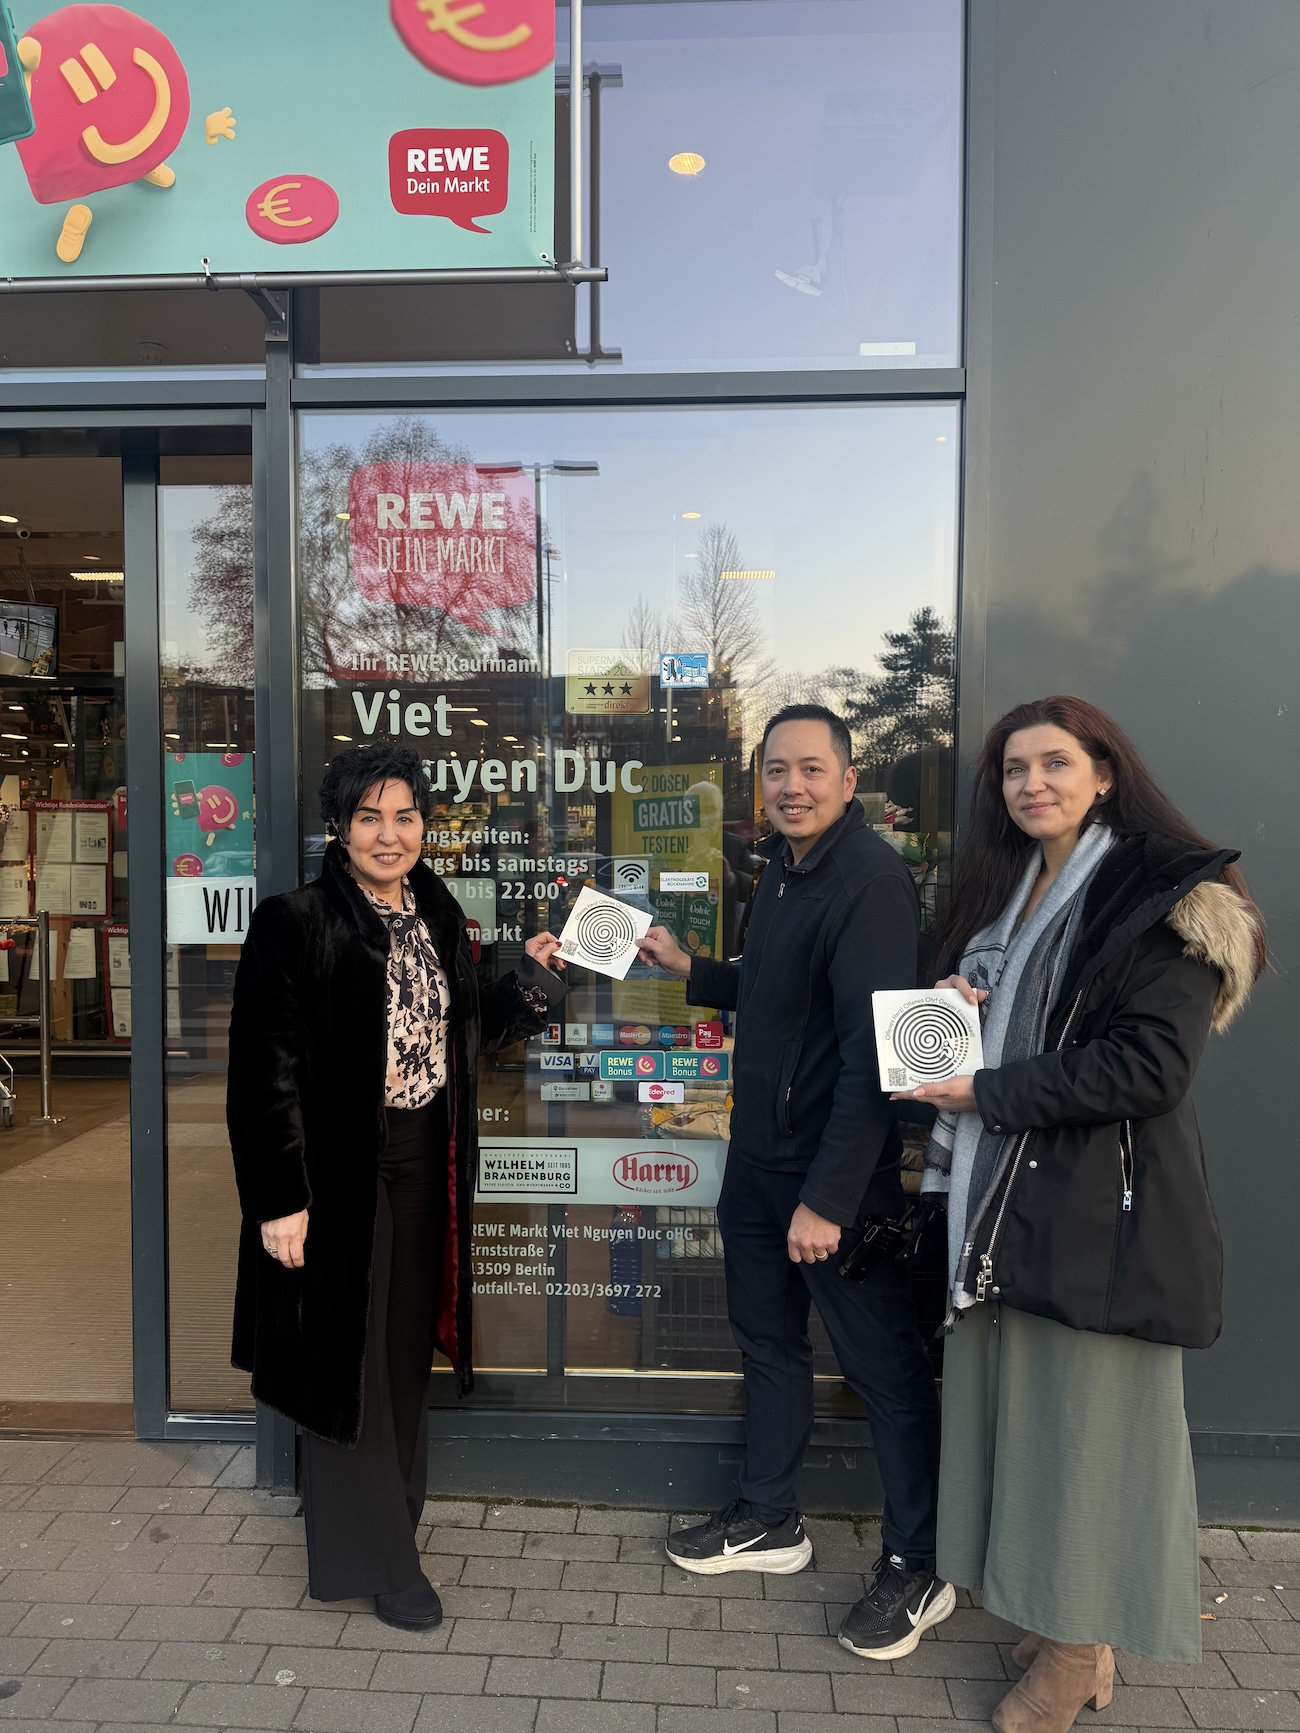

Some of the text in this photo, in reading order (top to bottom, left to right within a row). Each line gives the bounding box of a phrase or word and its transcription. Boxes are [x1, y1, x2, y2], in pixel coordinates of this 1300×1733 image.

[407, 147, 490, 172] REWE
[406, 177, 490, 194] Dein Markt
[377, 492, 508, 530] REWE
[378, 536, 508, 573] DEIN MARKT
[350, 653, 541, 672] Ihr REWE Kaufmann
[577, 655, 641, 665] SUPERMARKT
[577, 665, 611, 676] STARS
[352, 688, 453, 737] Viet
[604, 700, 630, 709] direkt
[554, 749, 644, 793] Duc
[652, 774, 690, 793] DOSEN
[423, 826, 530, 848] ngszeiten:
[641, 836, 690, 854] TESTEN!
[462, 853, 491, 872] bis
[497, 855, 590, 877] samstags
[466, 881, 495, 899] bis
[501, 881, 560, 900] 22.00
[699, 1029, 712, 1038] Pay
[543, 1056, 572, 1066] VISA
[608, 1057, 634, 1066] REWE
[672, 1058, 698, 1066] REWE
[608, 1067, 633, 1076] Bonus
[672, 1067, 697, 1076] Bonus
[485, 1160, 545, 1170] WILHELM
[620, 1156, 690, 1188] Harry
[484, 1172, 571, 1181] BRANDENBURG
[509, 1224, 548, 1239] Markt
[552, 1224, 579, 1239] Viet
[583, 1225, 633, 1242] Nguyen
[637, 1227, 662, 1240] Duc
[666, 1227, 694, 1240] oHG
[548, 1244, 557, 1257] 7
[515, 1263, 555, 1276] Berlin
[545, 1282, 631, 1298] 02203/3697
[635, 1284, 662, 1298] 272
